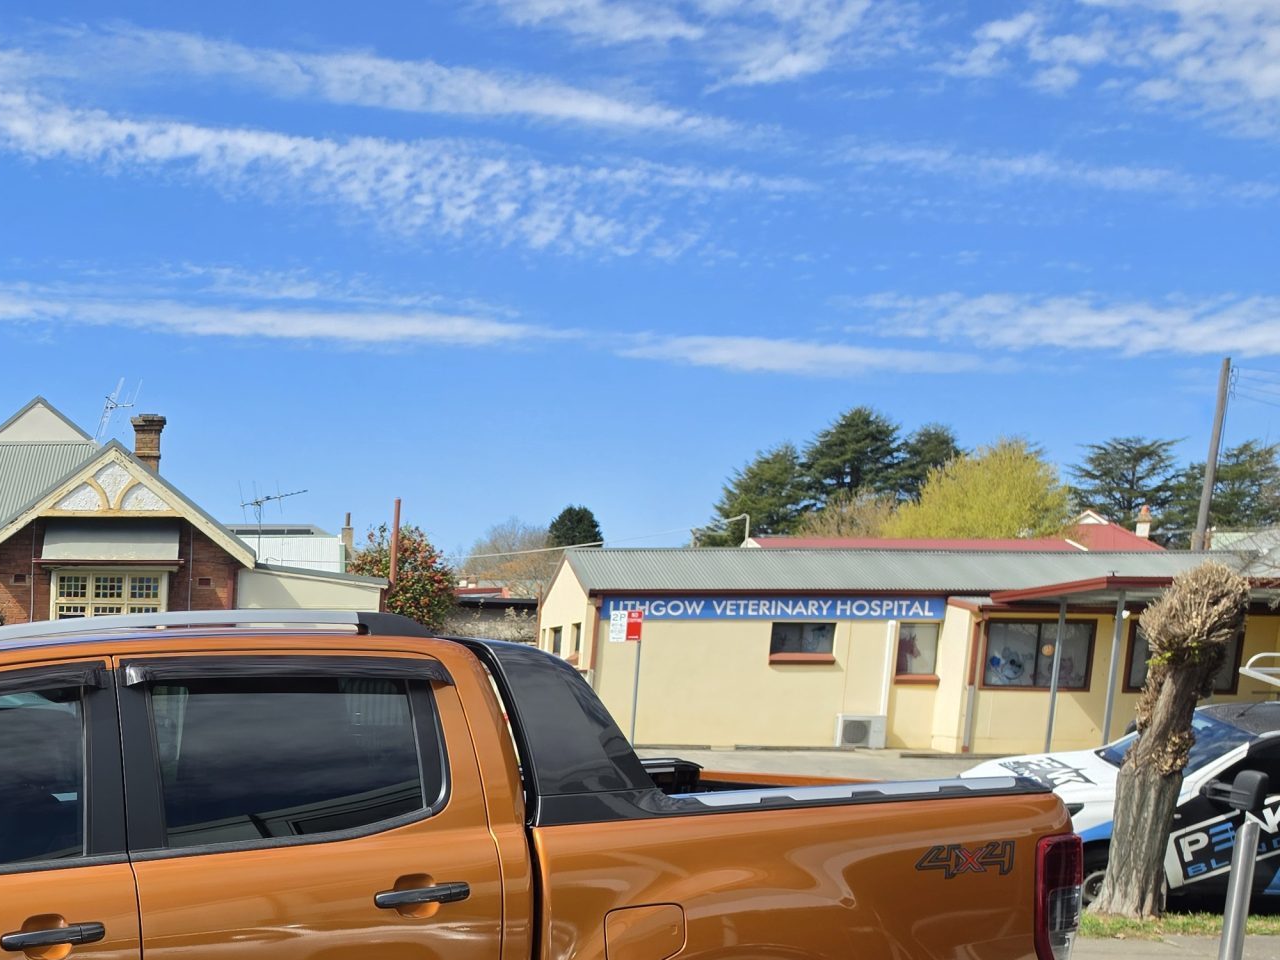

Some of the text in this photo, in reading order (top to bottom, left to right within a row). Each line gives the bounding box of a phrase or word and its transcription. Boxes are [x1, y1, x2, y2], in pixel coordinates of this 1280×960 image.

[712, 600, 832, 616] VETERINARY
[836, 600, 934, 616] HOSPITAL
[612, 613, 626, 621] 2P
